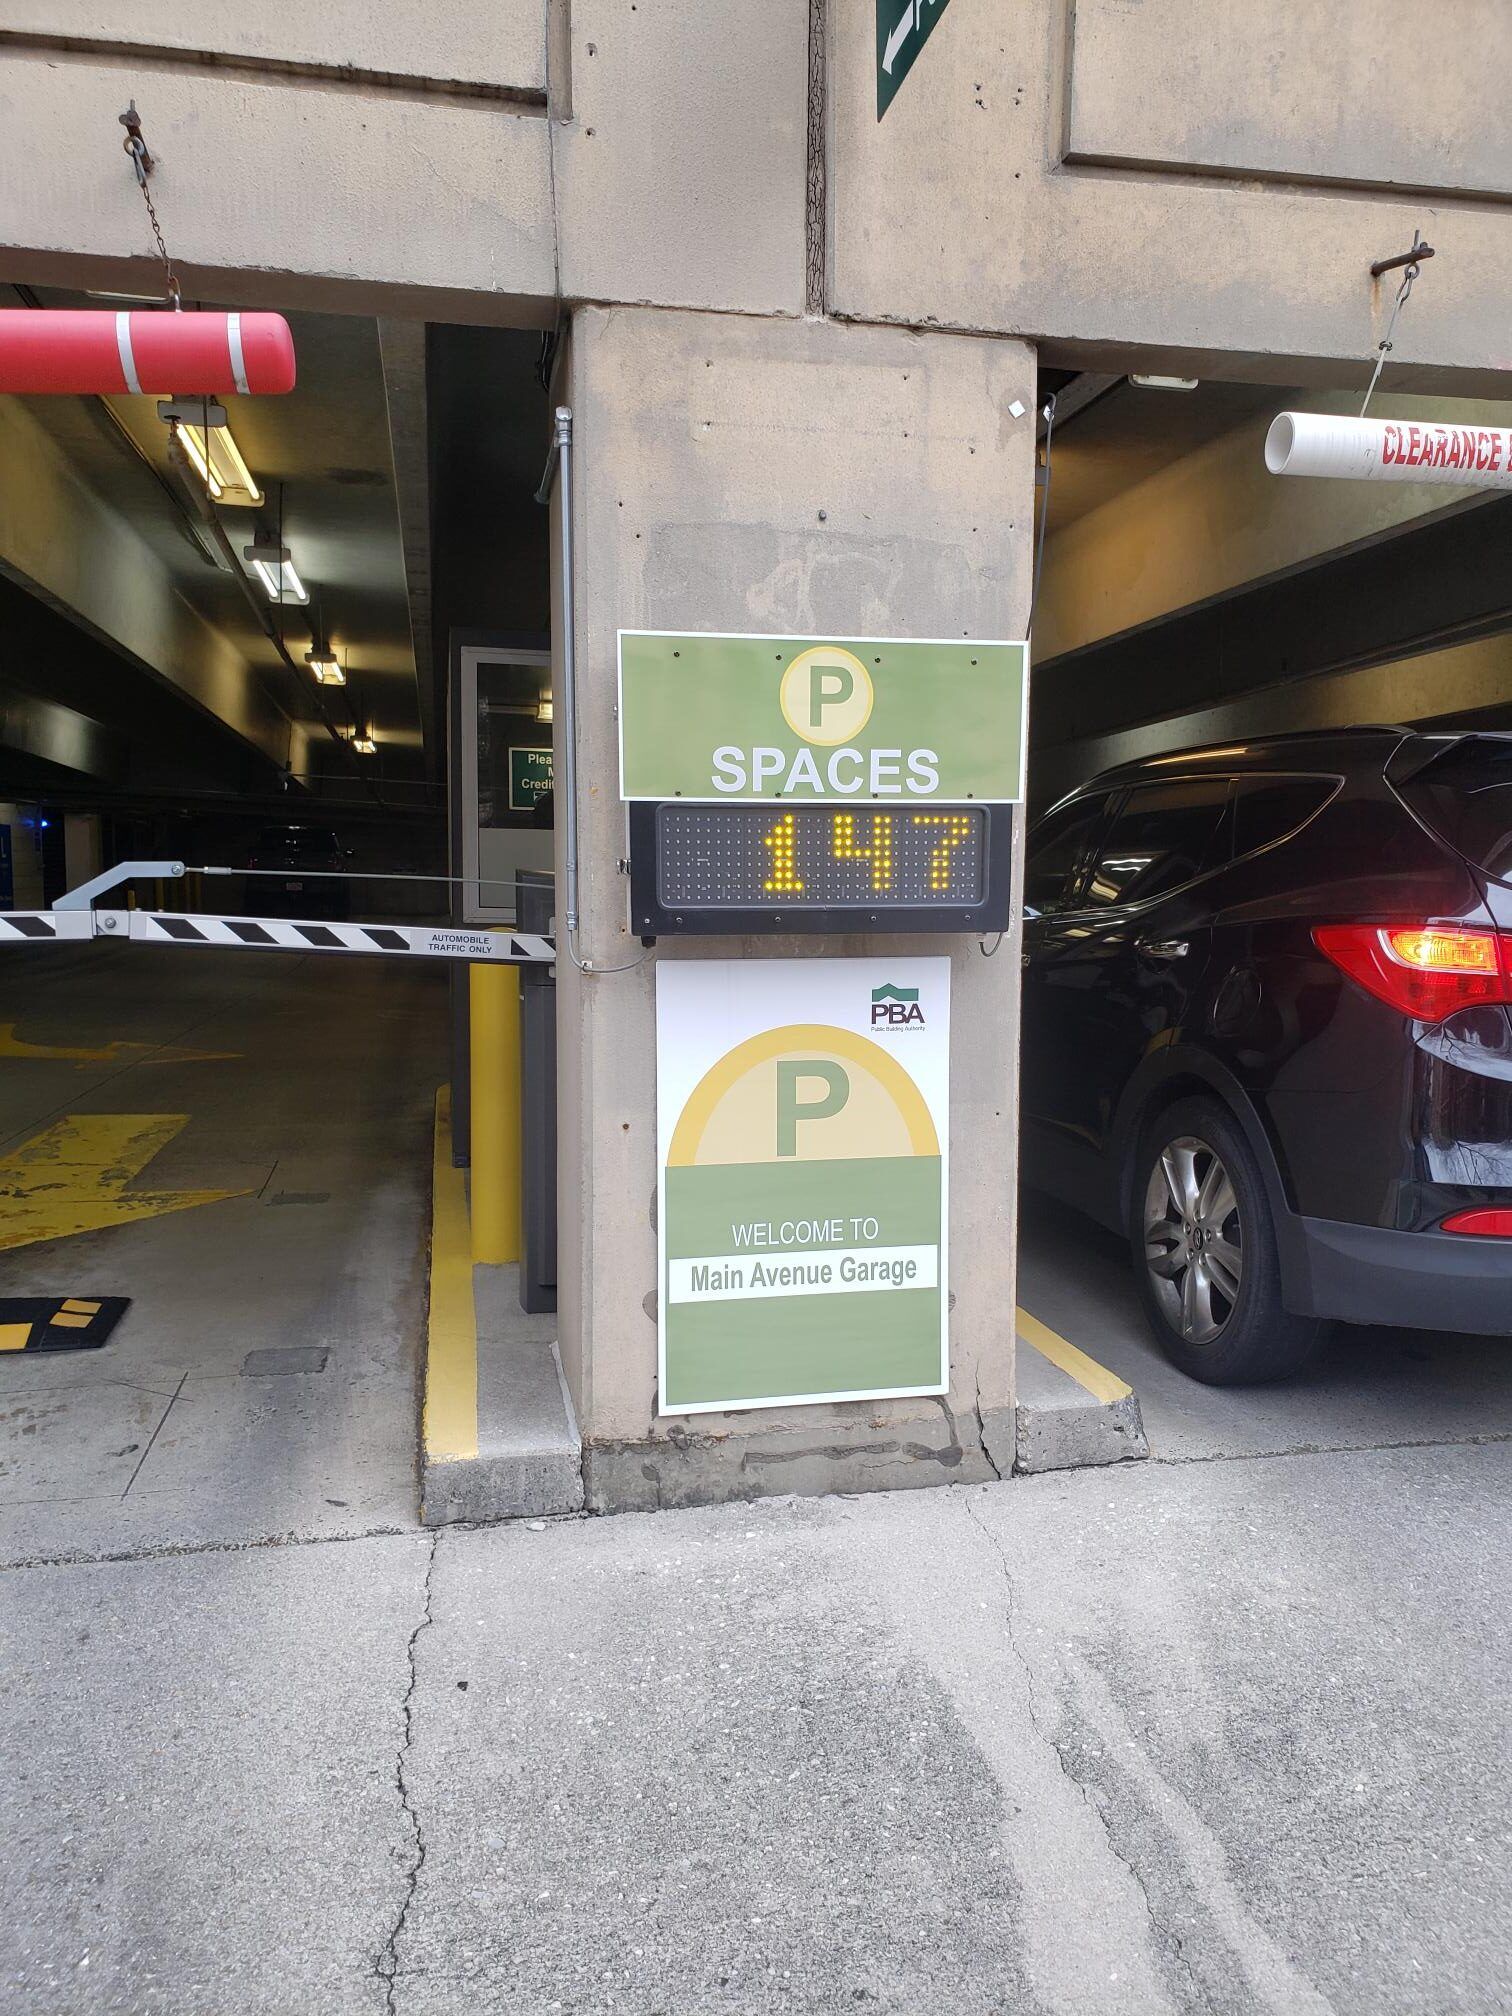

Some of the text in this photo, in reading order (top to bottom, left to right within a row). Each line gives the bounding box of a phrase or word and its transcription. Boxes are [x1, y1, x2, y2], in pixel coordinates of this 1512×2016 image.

[1382, 426, 1502, 471] CLEARANCE
[809, 665, 854, 727] P
[527, 753, 553, 765] Plea
[711, 746, 939, 794] SPACES
[765, 814, 969, 890] 147
[429, 943, 492, 954] TRAFFIC ONLY
[432, 934, 490, 945] AUTOMOBILE
[871, 1003, 926, 1025] PBA
[776, 1060, 850, 1157] P
[732, 1217, 879, 1247] WELCOME TO
[691, 1256, 917, 1292] Main Avenue Garage
